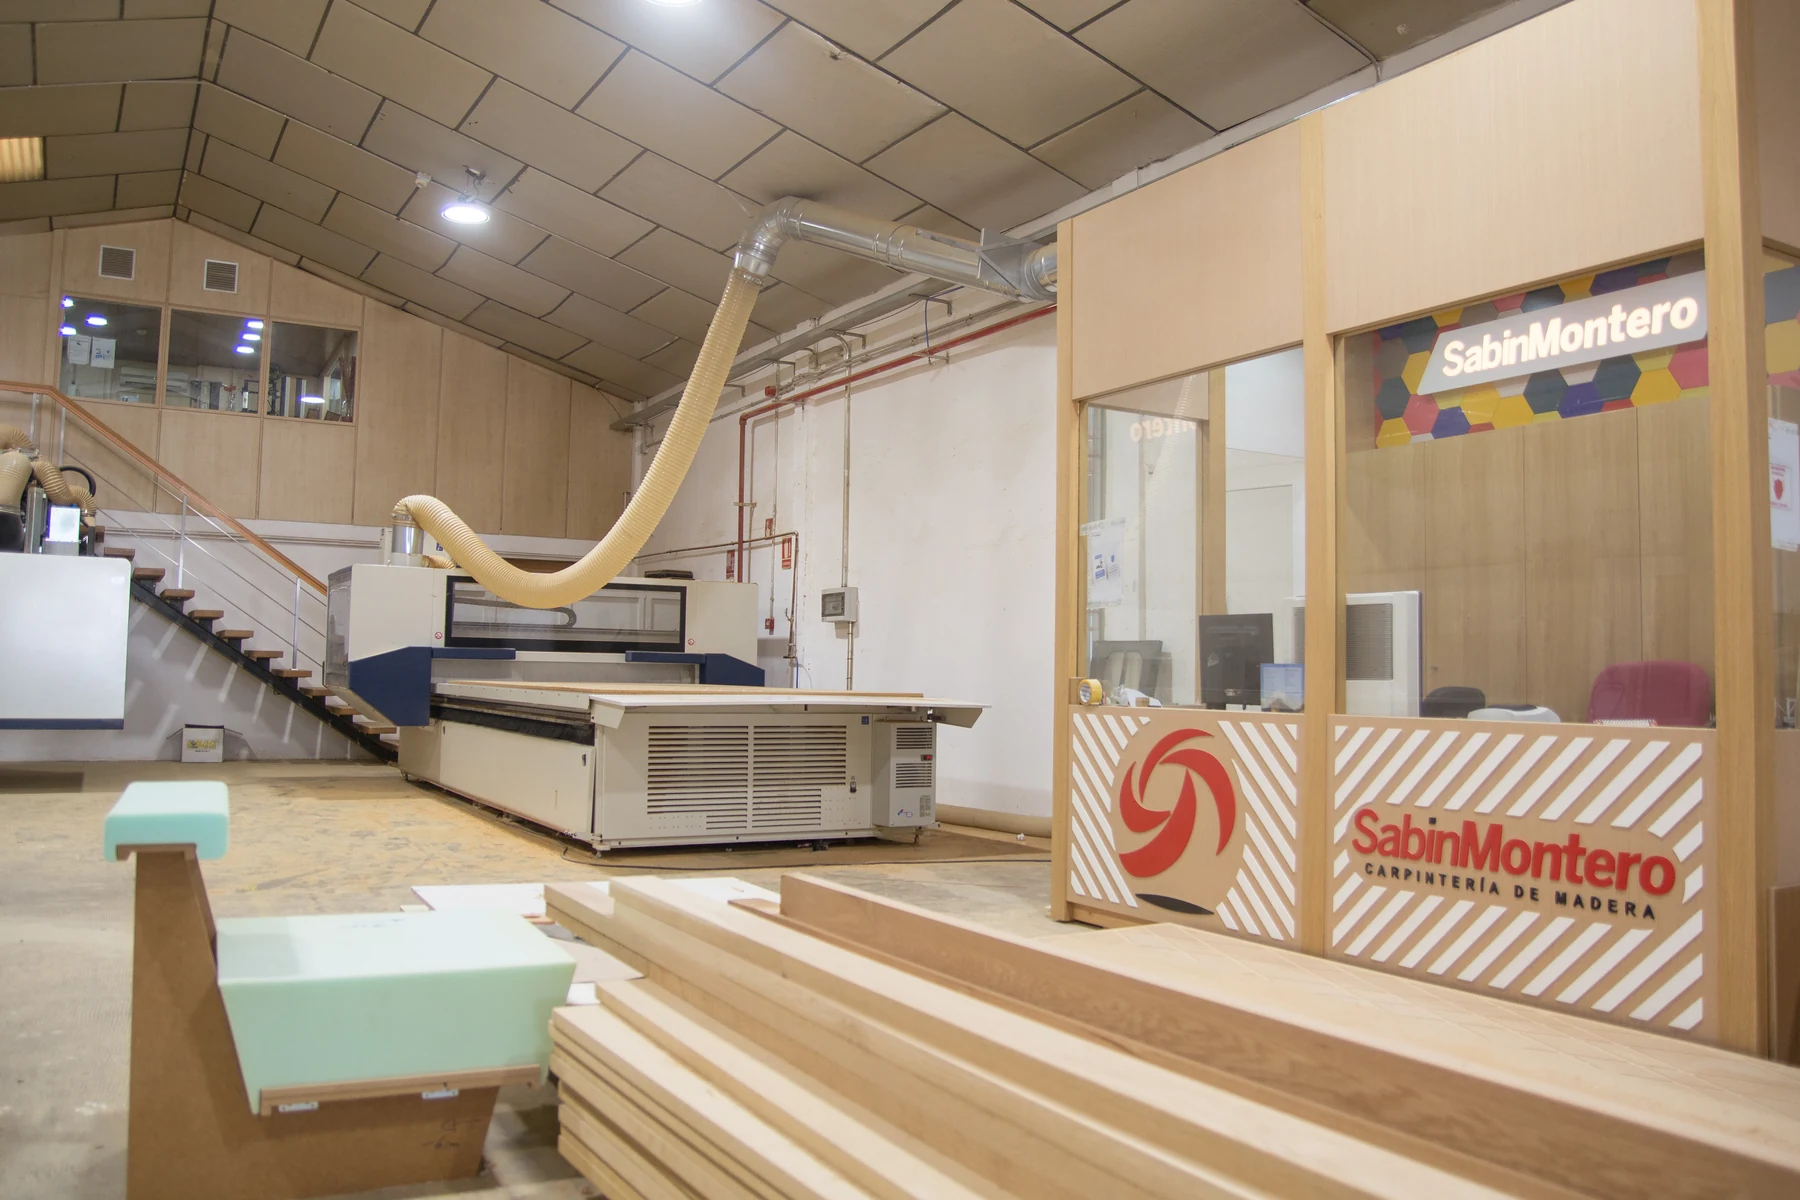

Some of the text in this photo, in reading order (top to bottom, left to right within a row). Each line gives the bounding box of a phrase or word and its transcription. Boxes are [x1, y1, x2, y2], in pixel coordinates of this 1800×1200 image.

[1441, 296, 1699, 378] SabinMontero
[1351, 808, 1677, 897] SabinMontero
[1364, 862, 1656, 920] CARPINTERÍA DE MADERA
